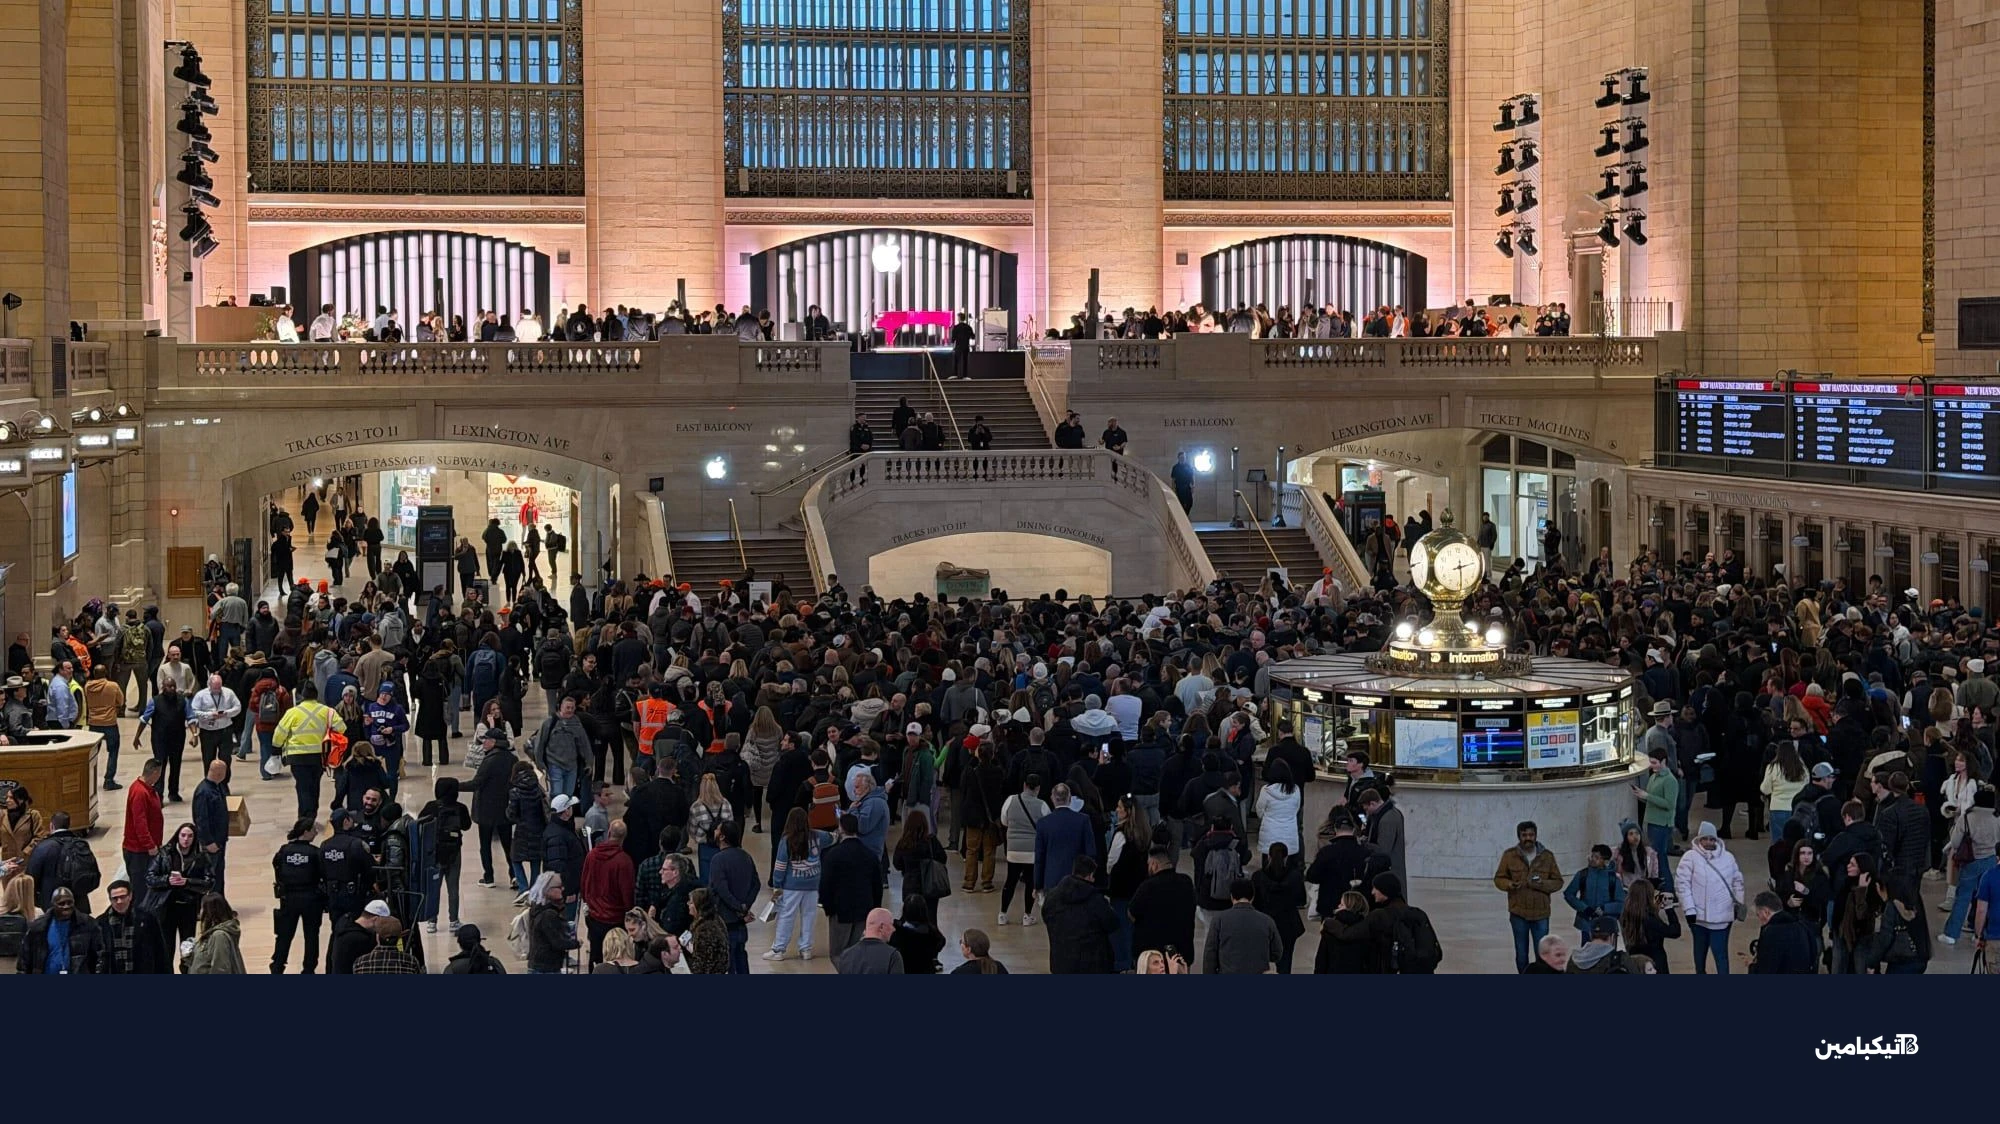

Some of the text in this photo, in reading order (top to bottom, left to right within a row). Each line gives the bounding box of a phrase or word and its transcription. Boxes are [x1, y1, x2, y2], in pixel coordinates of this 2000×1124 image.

[1819, 384, 1831, 392] NEW
[1832, 384, 1850, 392] HAVEN
[1864, 384, 1897, 393] DEPARTURES
[1965, 386, 1979, 395] NEW
[676, 423, 753, 432] EAST BALCONY
[1164, 417, 1236, 427] EAST BALCONY
[1331, 413, 1435, 441] LEXINGTON AVE
[1479, 413, 1592, 441] TICKET MACHINES
[285, 425, 399, 453] TRACKS 21 TO 11
[452, 424, 571, 451] LEXINGTON AVE
[325, 459, 369, 475] STREET
[373, 455, 425, 467] PASSAGE
[437, 455, 487, 468] SUBWAY
[488, 484, 537, 496] lovepop
[891, 528, 925, 545] TRACKS
[941, 523, 954, 532] TO
[1016, 520, 1105, 545] DINING CONCOURSE
[1449, 652, 1498, 664] Information
